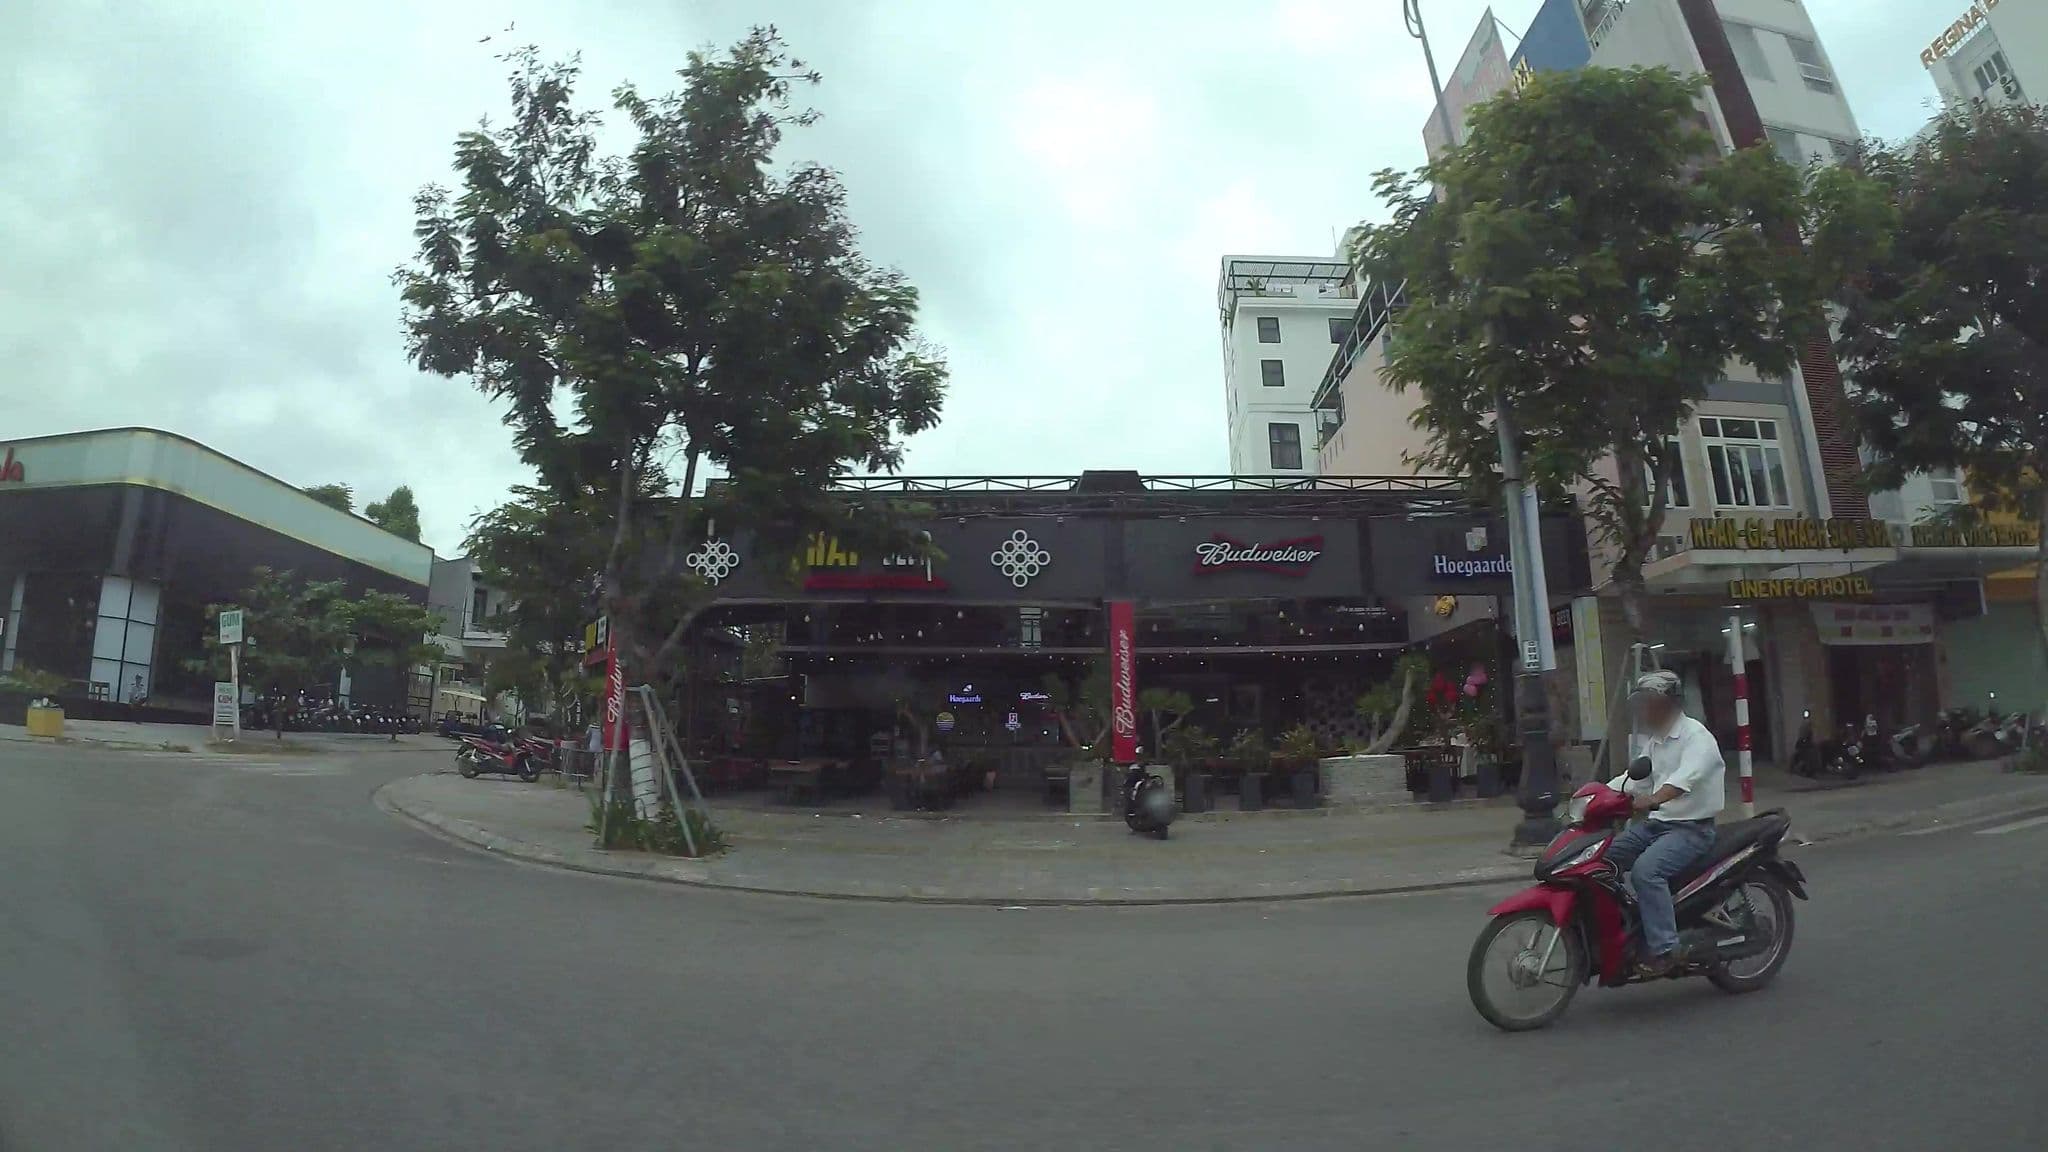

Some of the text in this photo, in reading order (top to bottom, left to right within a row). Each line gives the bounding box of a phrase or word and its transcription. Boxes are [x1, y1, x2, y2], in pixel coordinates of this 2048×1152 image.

[1919, 5, 1985, 67] REGINA
[1196, 542, 1321, 565] Budweiser
[1434, 554, 1513, 576] Hoegaarde
[1783, 578, 1818, 597] FOR
[1820, 576, 1873, 596] HOTEL
[1115, 629, 1134, 734] Budweiser
